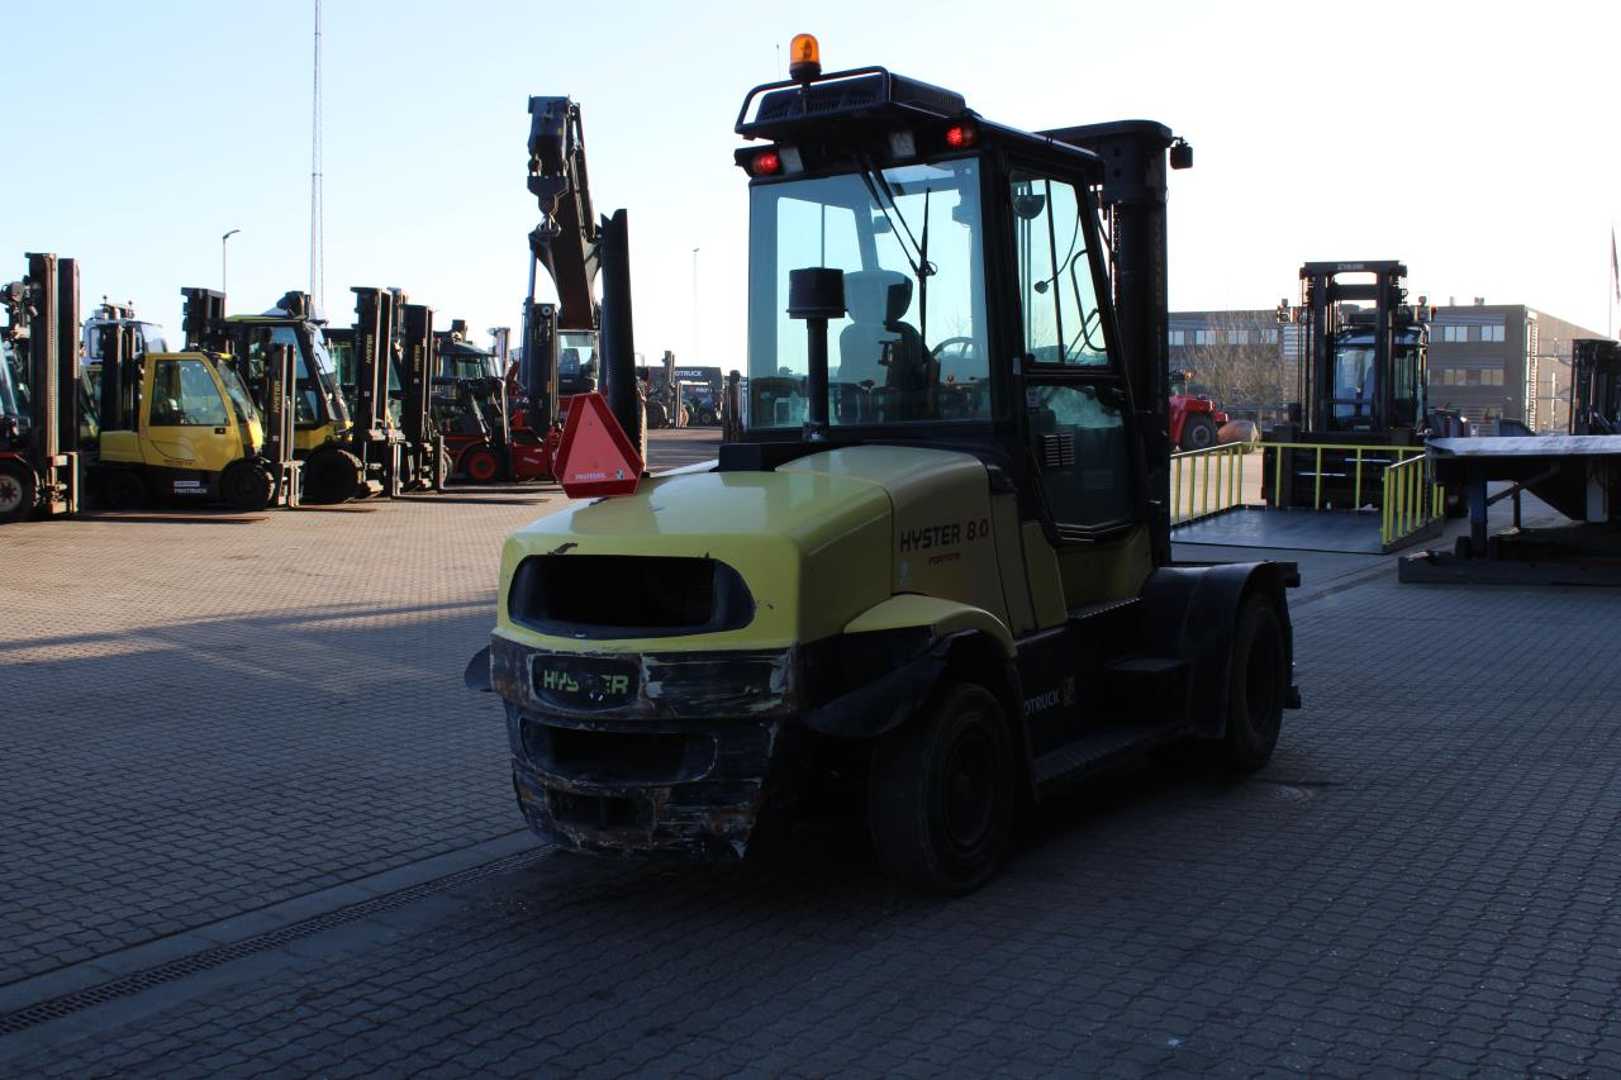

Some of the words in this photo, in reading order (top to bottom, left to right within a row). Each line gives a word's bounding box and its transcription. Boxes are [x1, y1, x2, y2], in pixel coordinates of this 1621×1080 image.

[899, 523, 961, 552] HYSTER
[543, 669, 630, 695] HYSER
[1024, 689, 1064, 715] OTRUCK
